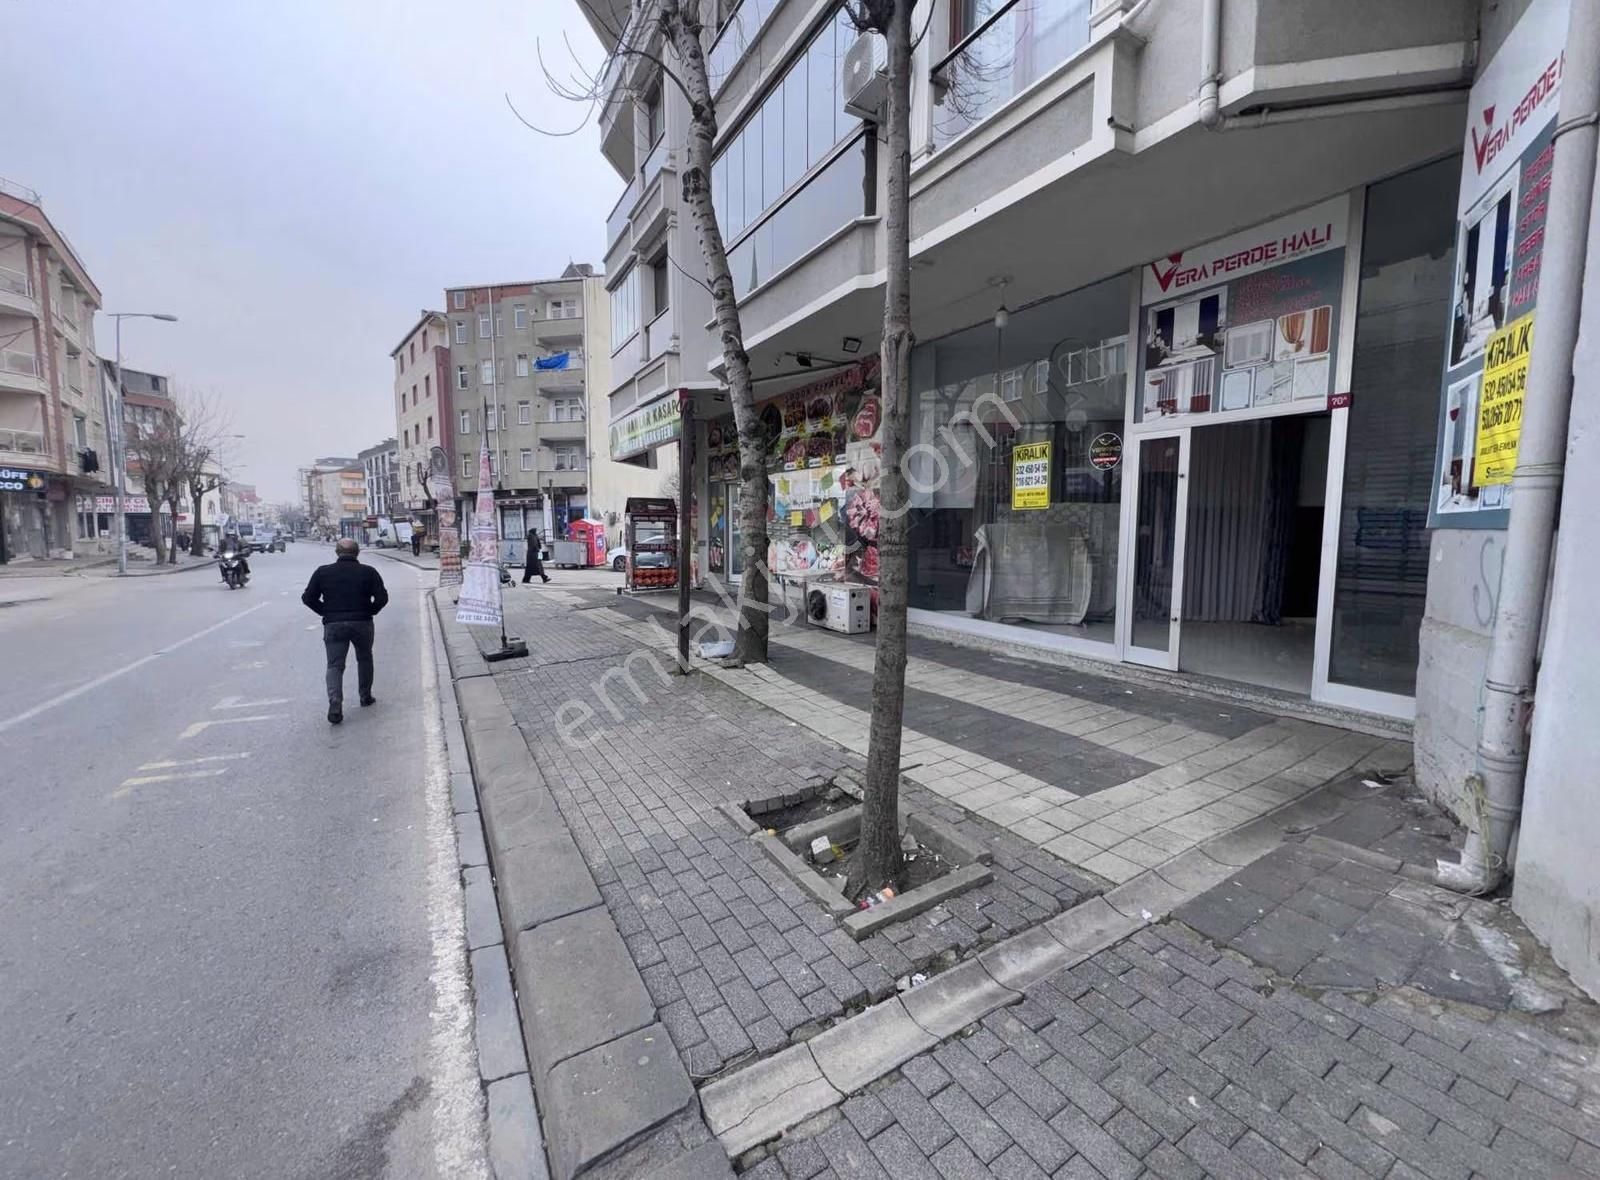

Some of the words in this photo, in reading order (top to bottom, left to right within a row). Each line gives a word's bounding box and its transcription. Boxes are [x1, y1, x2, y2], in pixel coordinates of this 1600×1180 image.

[1512, 58, 1557, 136] PERDE
[1152, 251, 1208, 292] VERA
[1212, 241, 1277, 276] PERDE
[1282, 223, 1332, 254] HALI
